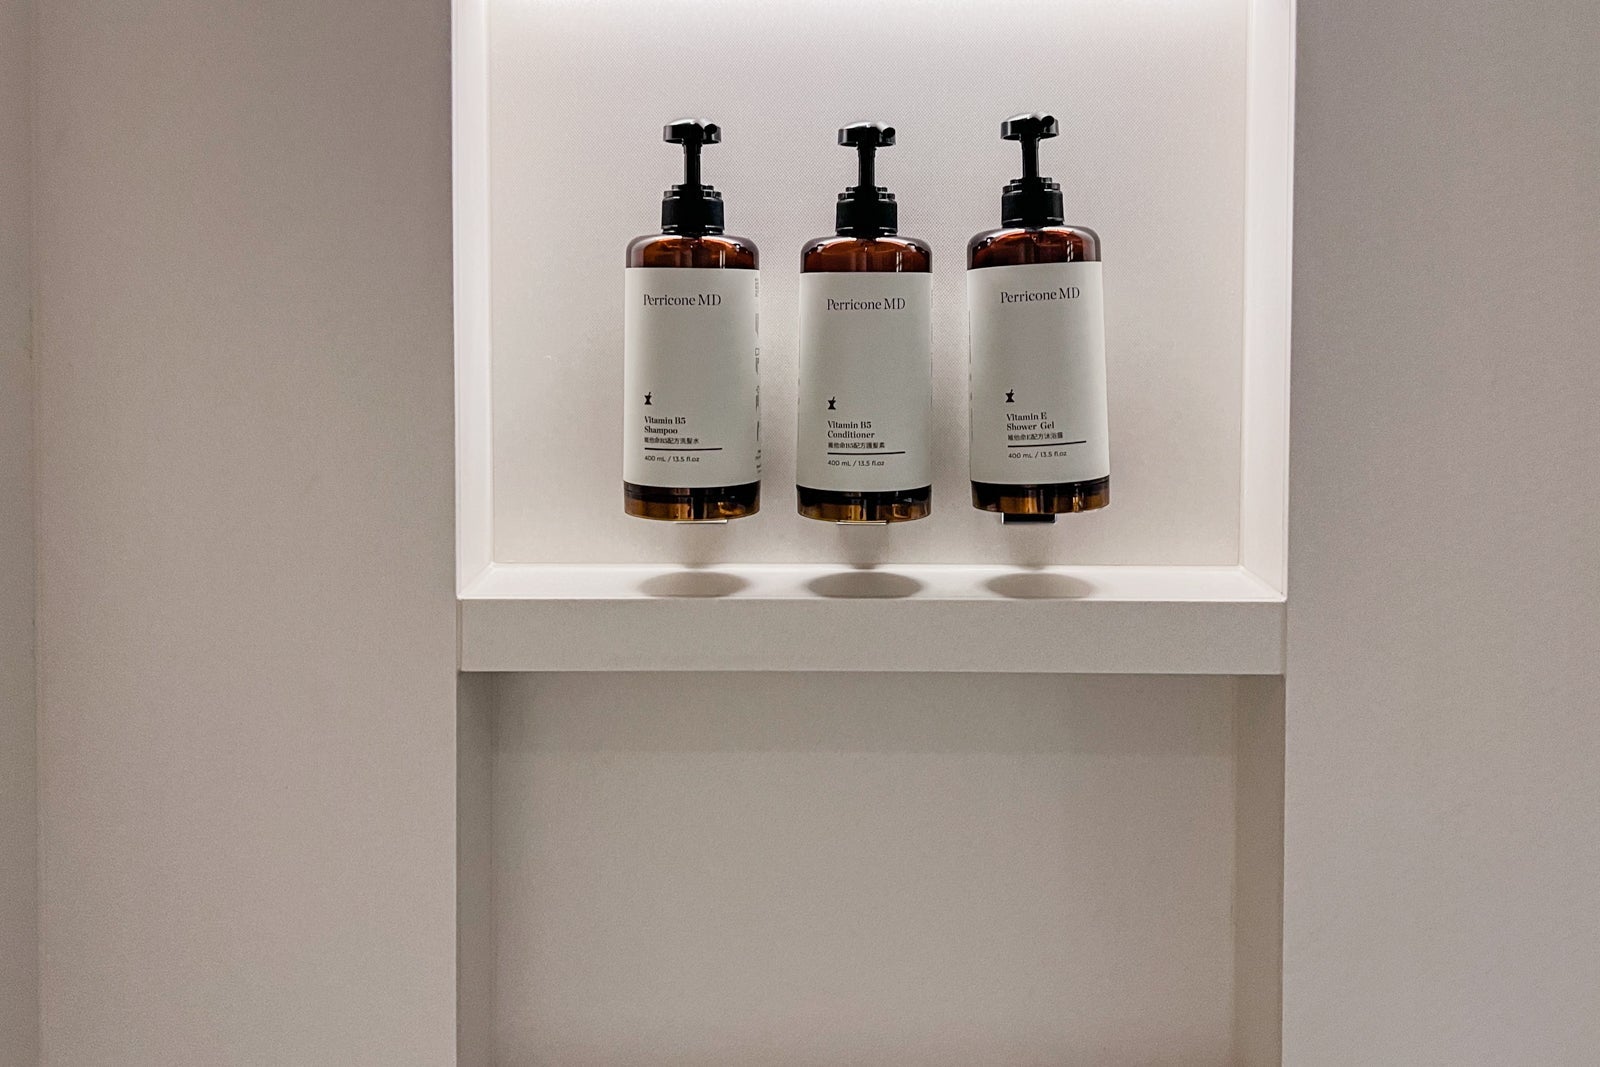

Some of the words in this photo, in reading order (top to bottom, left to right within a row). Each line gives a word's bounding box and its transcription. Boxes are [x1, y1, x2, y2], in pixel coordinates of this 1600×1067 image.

[643, 294, 696, 306] Perricone
[697, 293, 722, 306] MD
[1000, 290, 1057, 304] Perricone
[1059, 287, 1080, 300] MD
[827, 298, 882, 311] Perricone
[884, 297, 906, 310] MD
[644, 415, 673, 424] Vitamin
[675, 416, 686, 424] B5
[1006, 413, 1039, 421] Vitamin
[1040, 412, 1048, 420] E
[827, 420, 859, 429] Vitamin
[860, 421, 872, 429] B5
[1006, 423, 1037, 431] Shower
[1040, 421, 1055, 429] Gel
[644, 425, 678, 435] Shampoo
[827, 430, 876, 439] Conditioner
